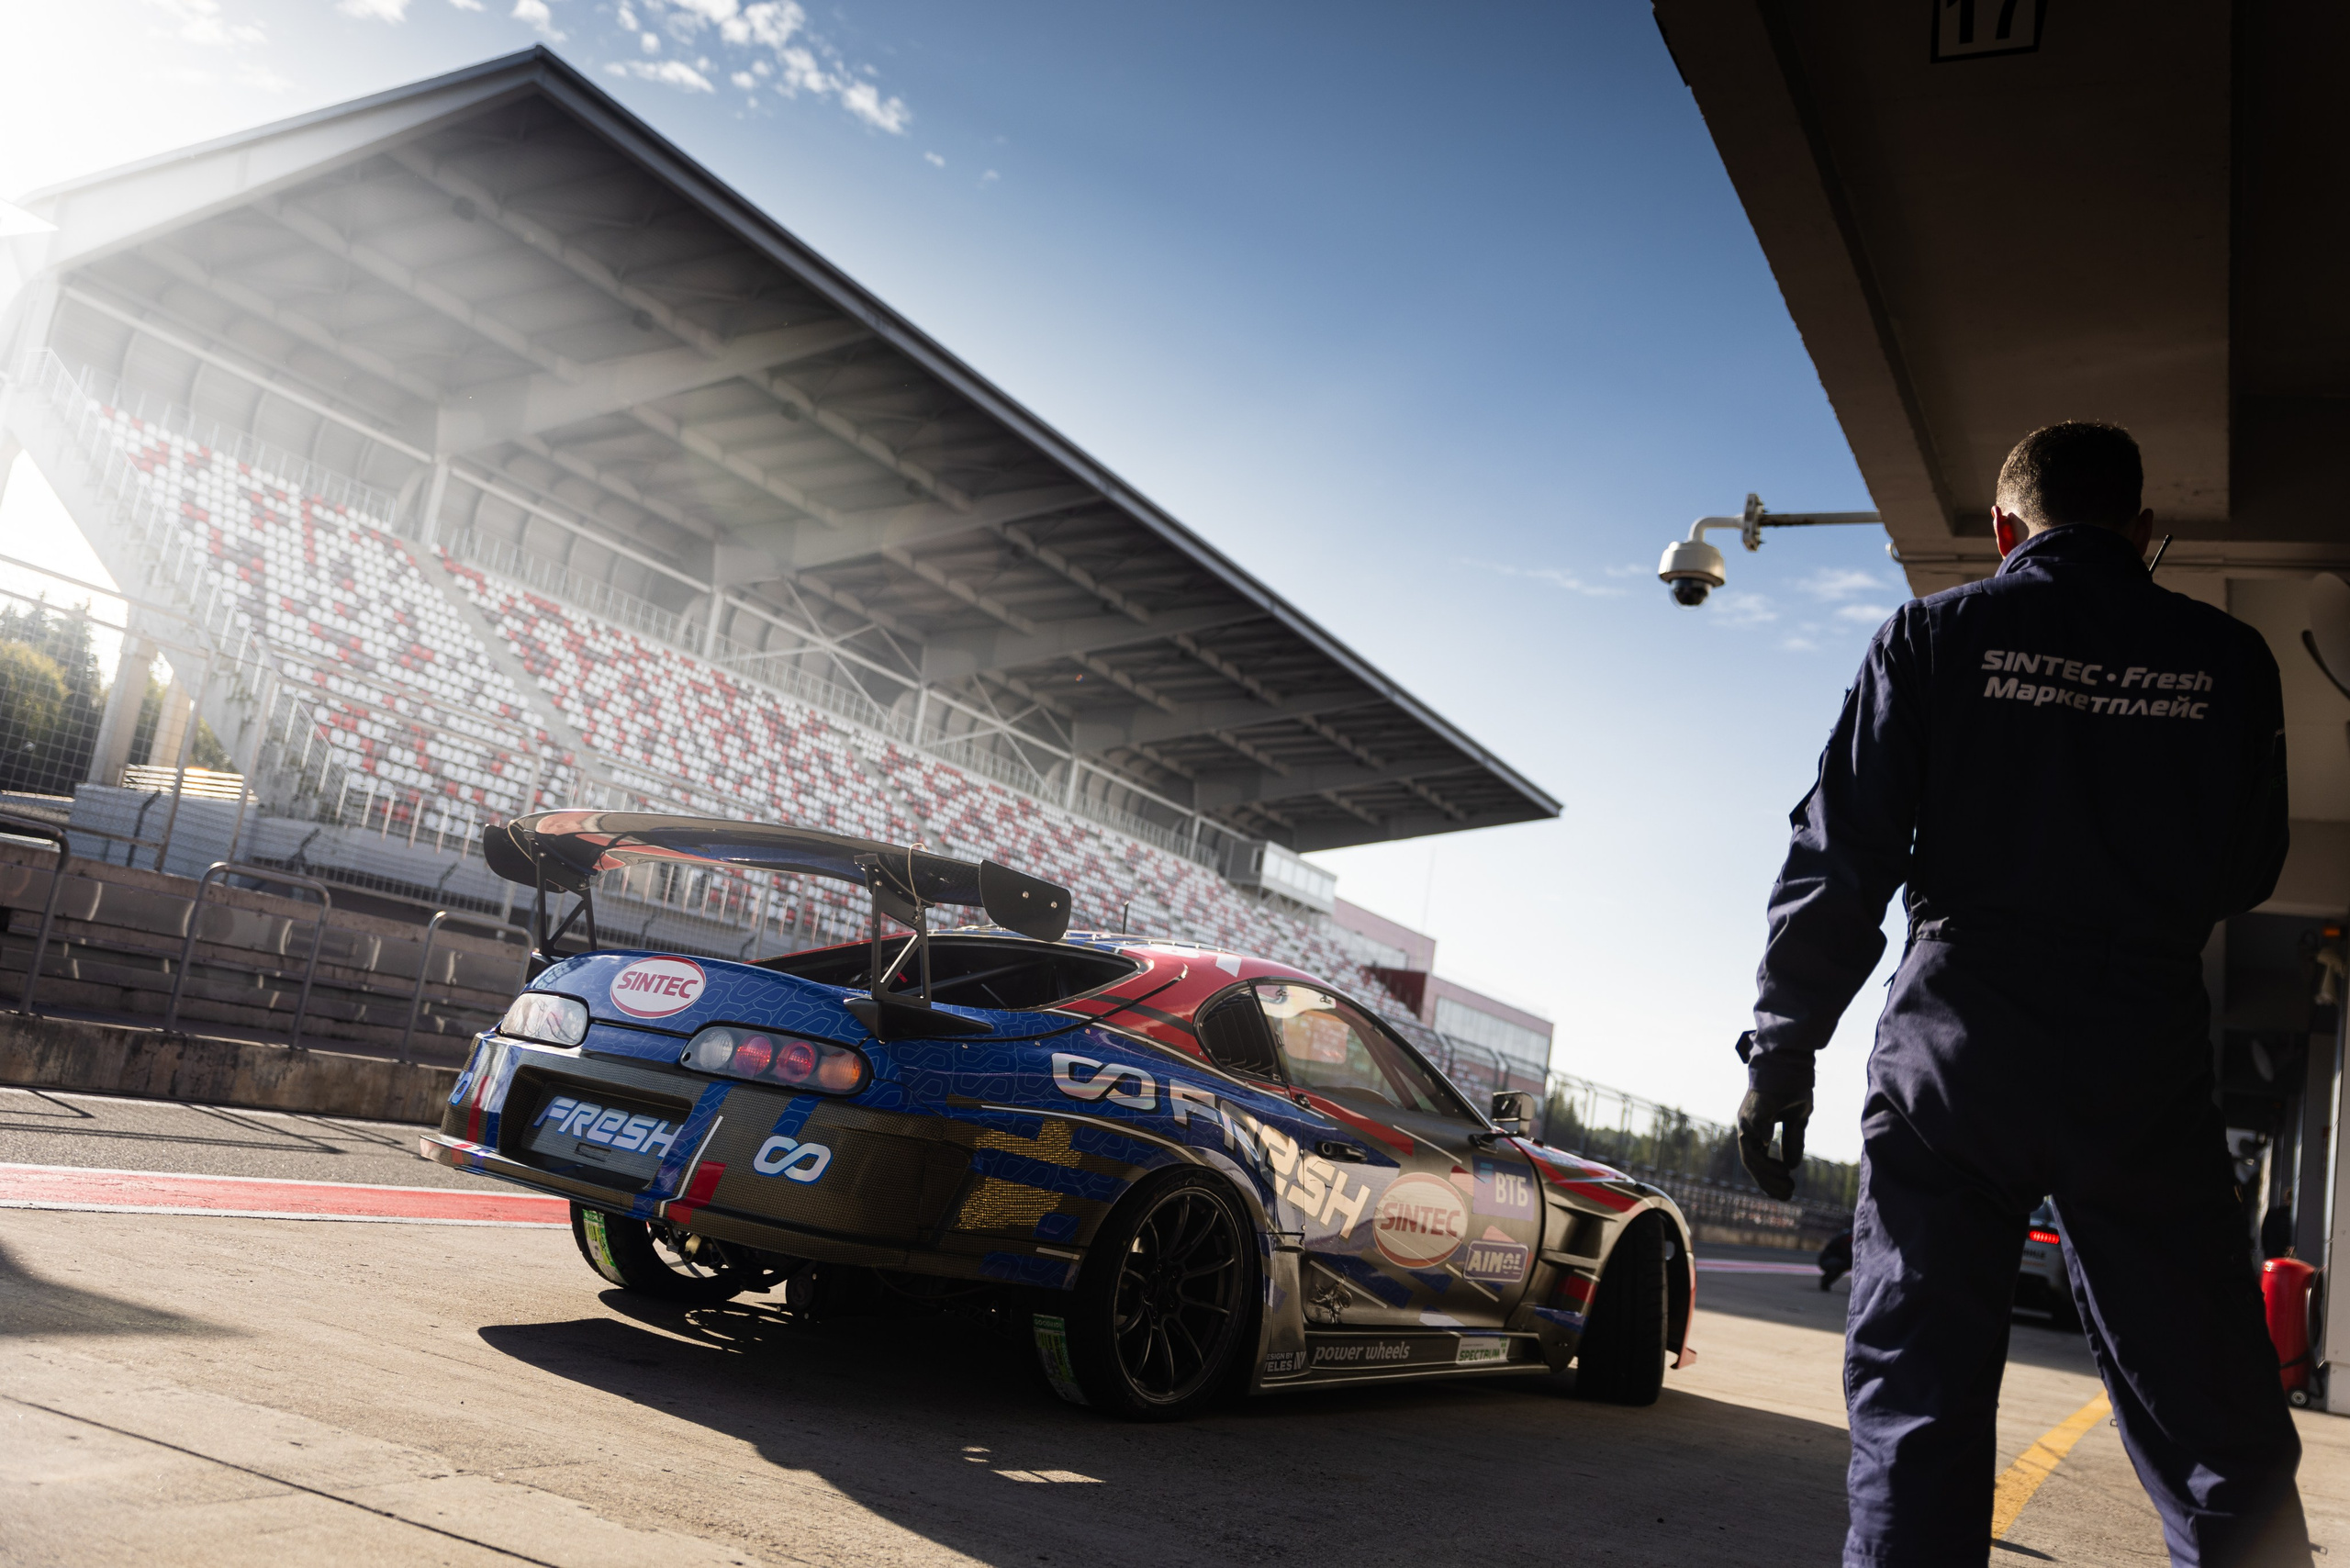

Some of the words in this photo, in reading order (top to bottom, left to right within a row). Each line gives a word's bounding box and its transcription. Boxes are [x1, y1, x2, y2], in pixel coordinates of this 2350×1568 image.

[1981, 650, 2102, 686] SINTEC
[2121, 666, 2213, 691] Fresh
[1984, 677, 2209, 720] Маркетплейс
[617, 970, 699, 999] SINTEC
[1494, 1171, 1528, 1207] ВТБ
[1380, 1202, 1460, 1238] SINTEC
[1467, 1249, 1523, 1275] AIMOL
[1266, 1352, 1285, 1361] ESIGN
[1312, 1345, 1363, 1365] power
[1365, 1340, 1410, 1360] wheels
[1459, 1349, 1500, 1361] SPECTRUM
